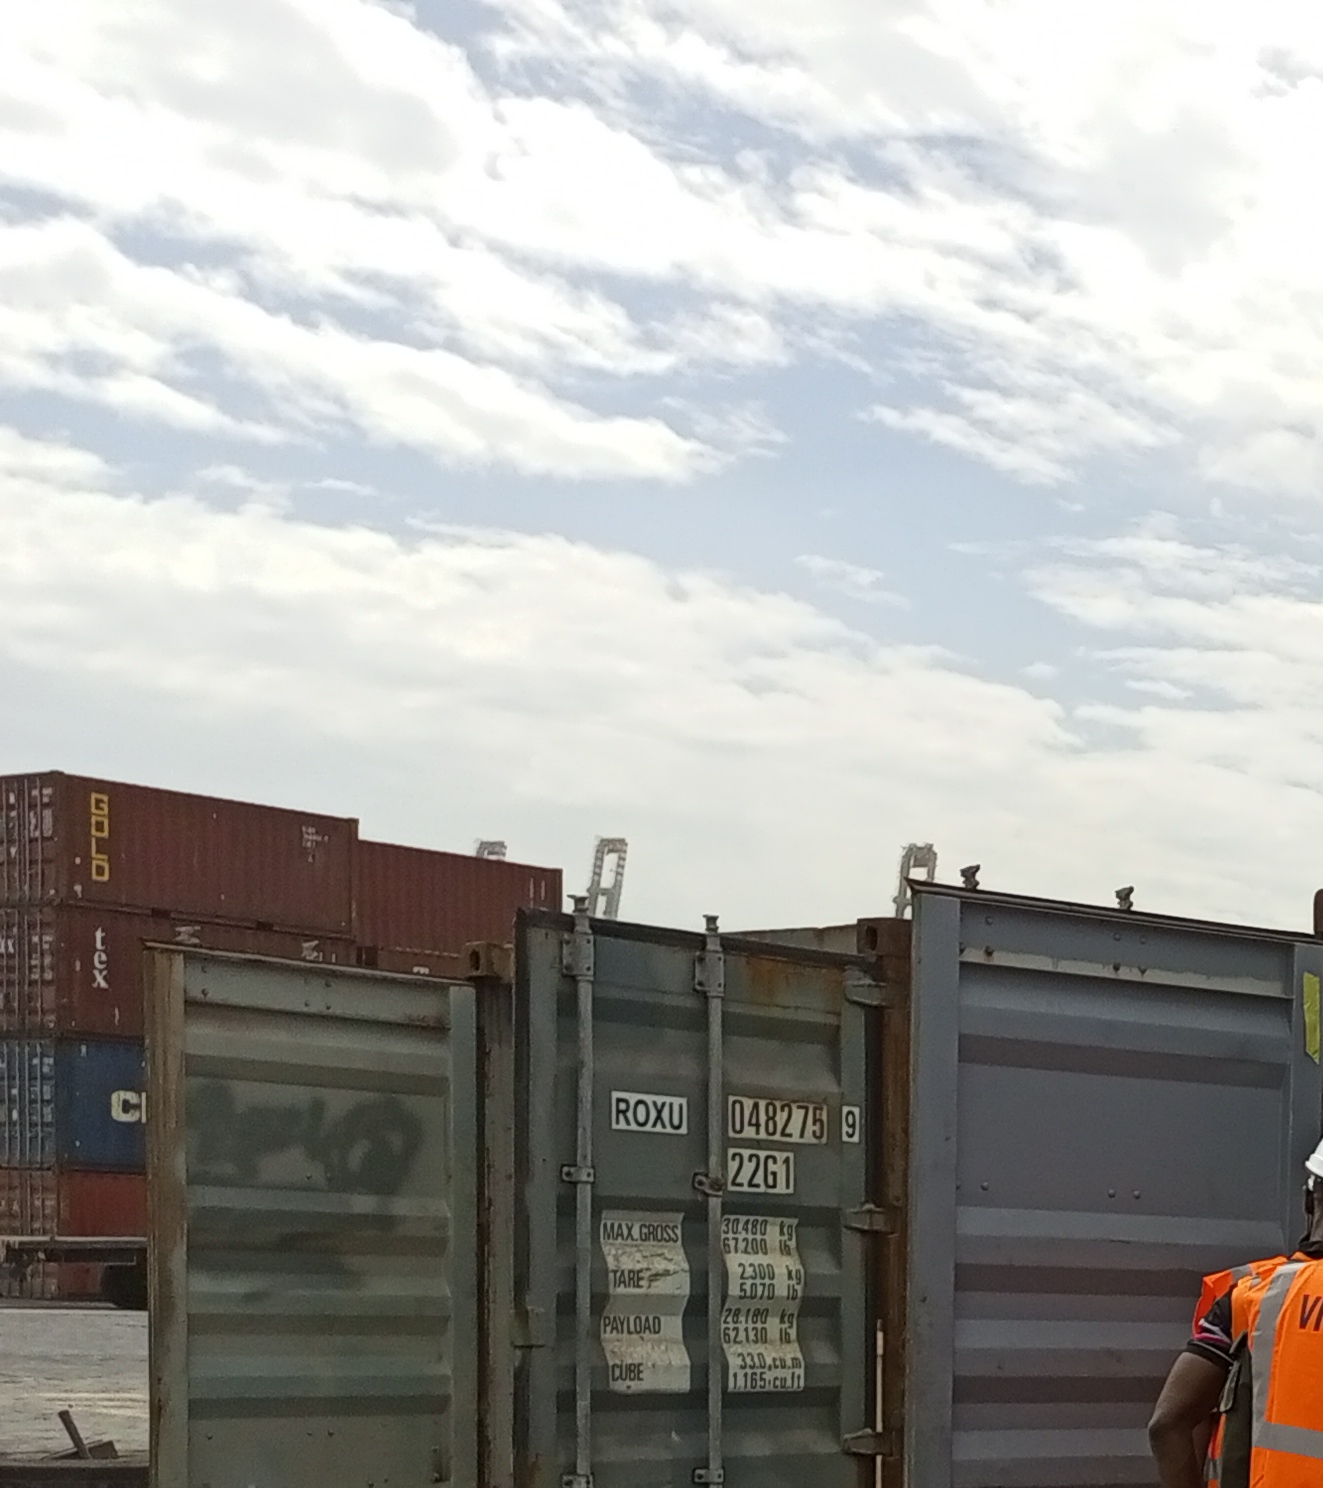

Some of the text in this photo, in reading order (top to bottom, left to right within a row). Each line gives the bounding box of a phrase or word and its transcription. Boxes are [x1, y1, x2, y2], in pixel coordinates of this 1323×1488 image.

[90, 792, 109, 882] GOLD
[92, 927, 109, 988] tex
[615, 1097, 856, 1139] ROXU 048275 9
[730, 1152, 791, 1190] 22G1
[722, 1217, 769, 1236] 30.480
[779, 1220, 794, 1241] kg
[722, 1237, 791, 1256] 67.200 lb
[612, 1269, 645, 1289] TARE
[786, 1264, 802, 1285] kg
[786, 1282, 798, 1300] lb
[602, 1315, 662, 1335] PAYLOAD
[779, 1308, 795, 1329] kg
[722, 1327, 791, 1345] 62.130 lb
[611, 1362, 644, 1382] CUBE
